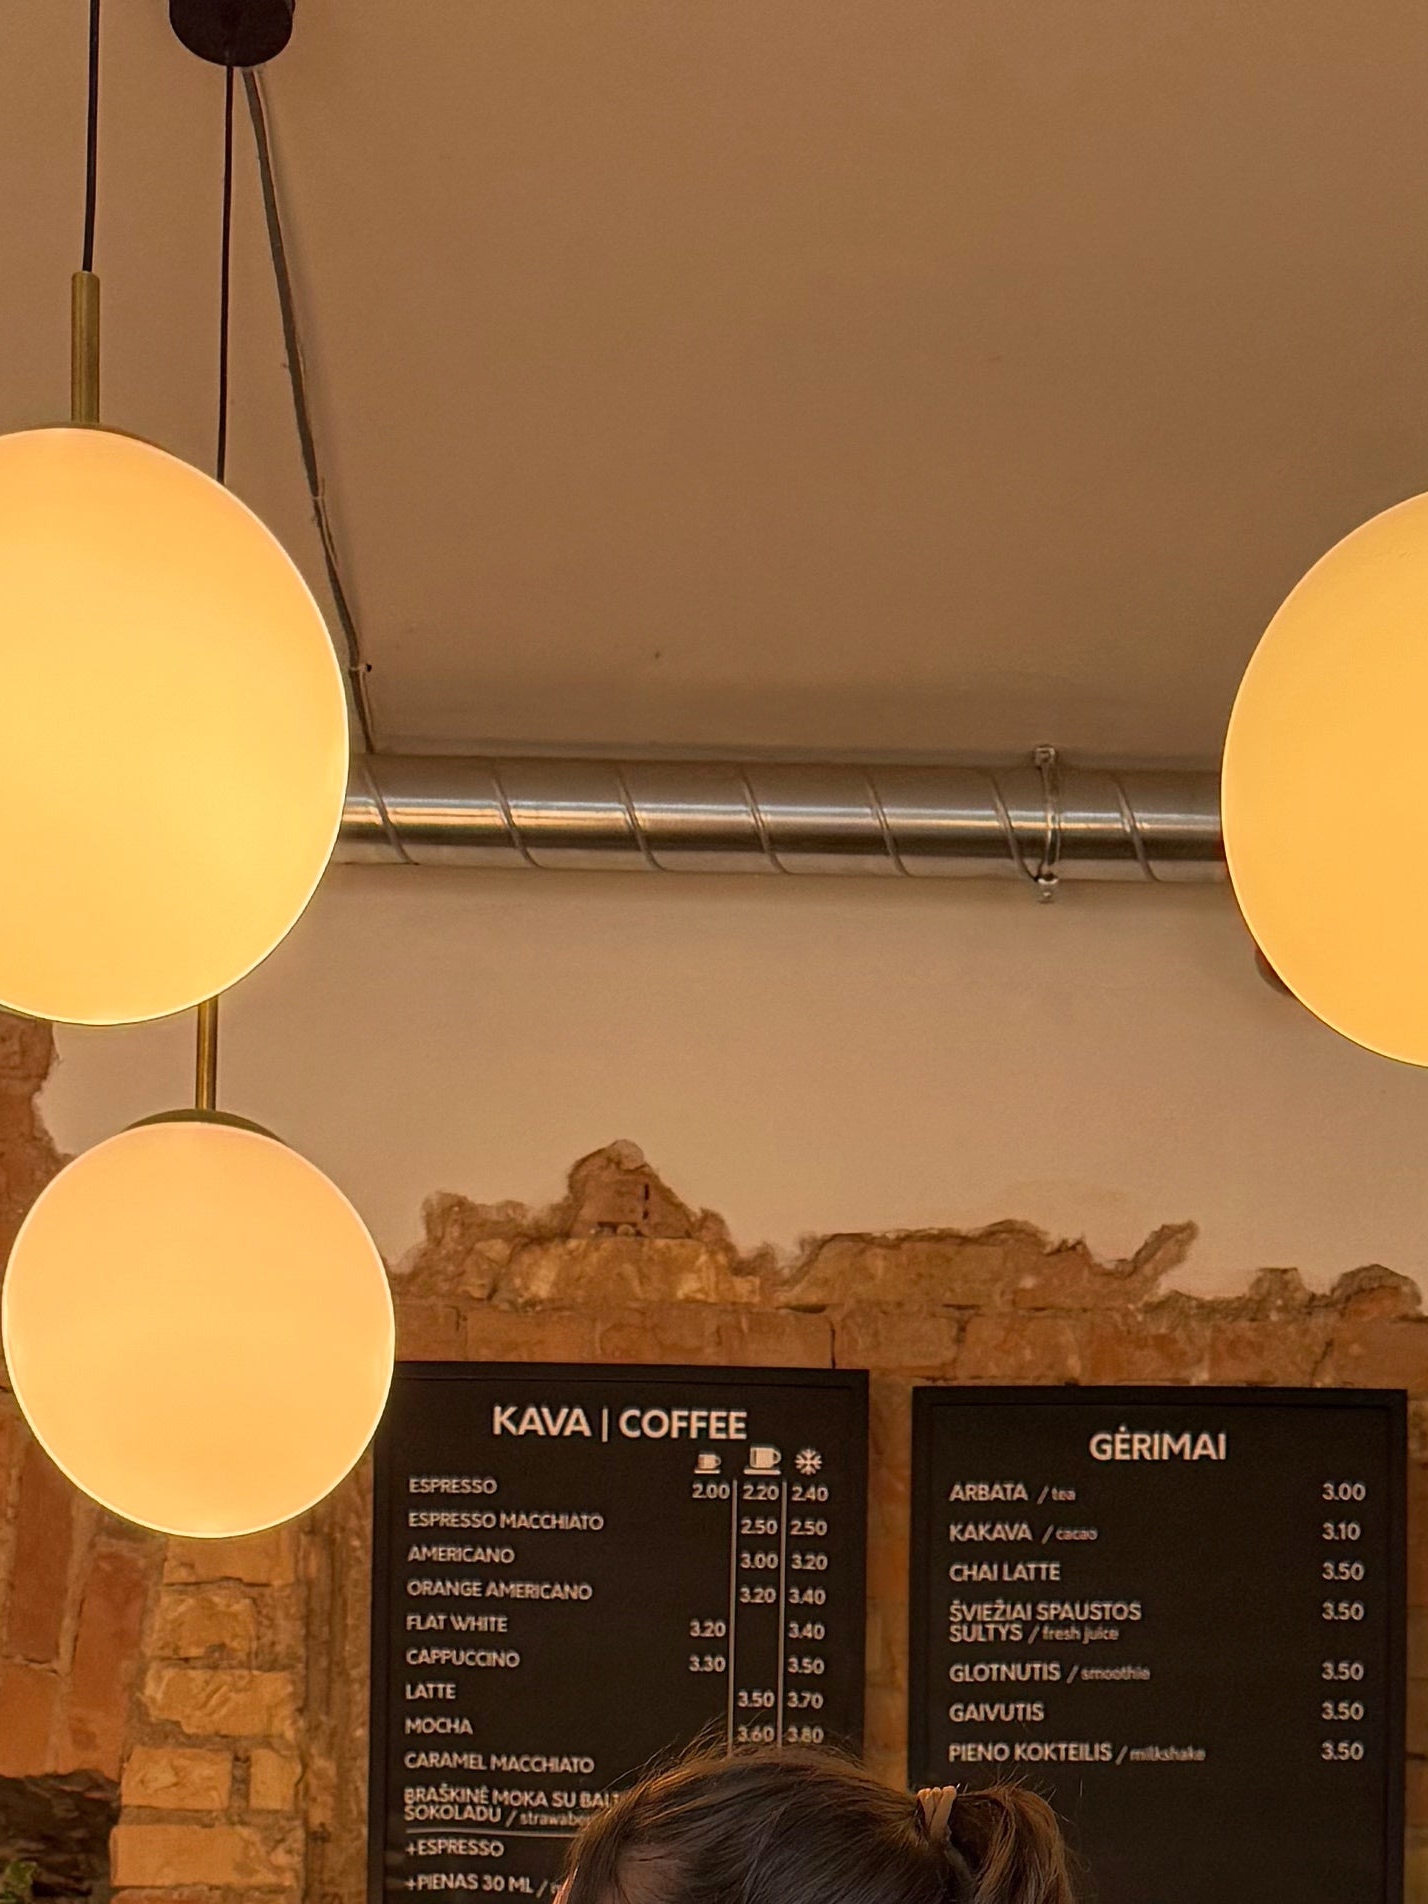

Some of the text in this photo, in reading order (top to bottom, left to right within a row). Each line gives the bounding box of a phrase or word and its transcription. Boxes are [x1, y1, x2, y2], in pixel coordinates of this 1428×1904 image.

[492, 1404, 747, 1440] KAVA COFFEE
[1089, 1423, 1227, 1461] GĖRIMAI
[409, 1478, 829, 1501] ESPRESSO 2.00 2.20 2.40
[949, 1483, 1028, 1501] ARBATA
[1323, 1482, 1366, 1501] 3.00
[408, 1513, 827, 1536] ESPRESSO MACCHIATO 2.50 2.50
[949, 1523, 1032, 1541] KAKAVA
[1323, 1522, 1360, 1541] 3.10
[408, 1546, 827, 1571] AMERICANO 3.00 3.20
[949, 1562, 1364, 1582] CHAI LATTE 3.50
[407, 1581, 825, 1605] ORANGE AMERICANO 3.20 3.40
[949, 1599, 1364, 1621] ŠVIEŽIAI SPAUSTOS 3.50
[406, 1615, 825, 1640] FLAT WHITE 3.20 3.40
[949, 1624, 1023, 1642] SULTYS
[1042, 1625, 1081, 1641] fresh
[406, 1649, 824, 1674] CAPPUCCINO 3.30 3.50
[949, 1664, 1061, 1682] GLOTNUTIS
[1321, 1662, 1364, 1681] 3.50
[405, 1683, 824, 1709] LATTE 3.50 3.70
[949, 1703, 1364, 1722] GAIVUTIS 3.50
[405, 1718, 824, 1744] MOCHA 3.60 3.80
[404, 1752, 595, 1773] CARAMEL MACCHIATO
[949, 1744, 1010, 1762] PIENO
[1014, 1743, 1112, 1762] KOKTEILIS
[1321, 1742, 1364, 1761] 3.50
[492, 1790, 549, 1808] MOKA
[553, 1791, 576, 1808] SU
[405, 1839, 505, 1857] +ESPRESSO
[405, 1873, 479, 1891] +PIENAS
[482, 1875, 506, 1891] 30
[508, 1875, 534, 1894] ML
